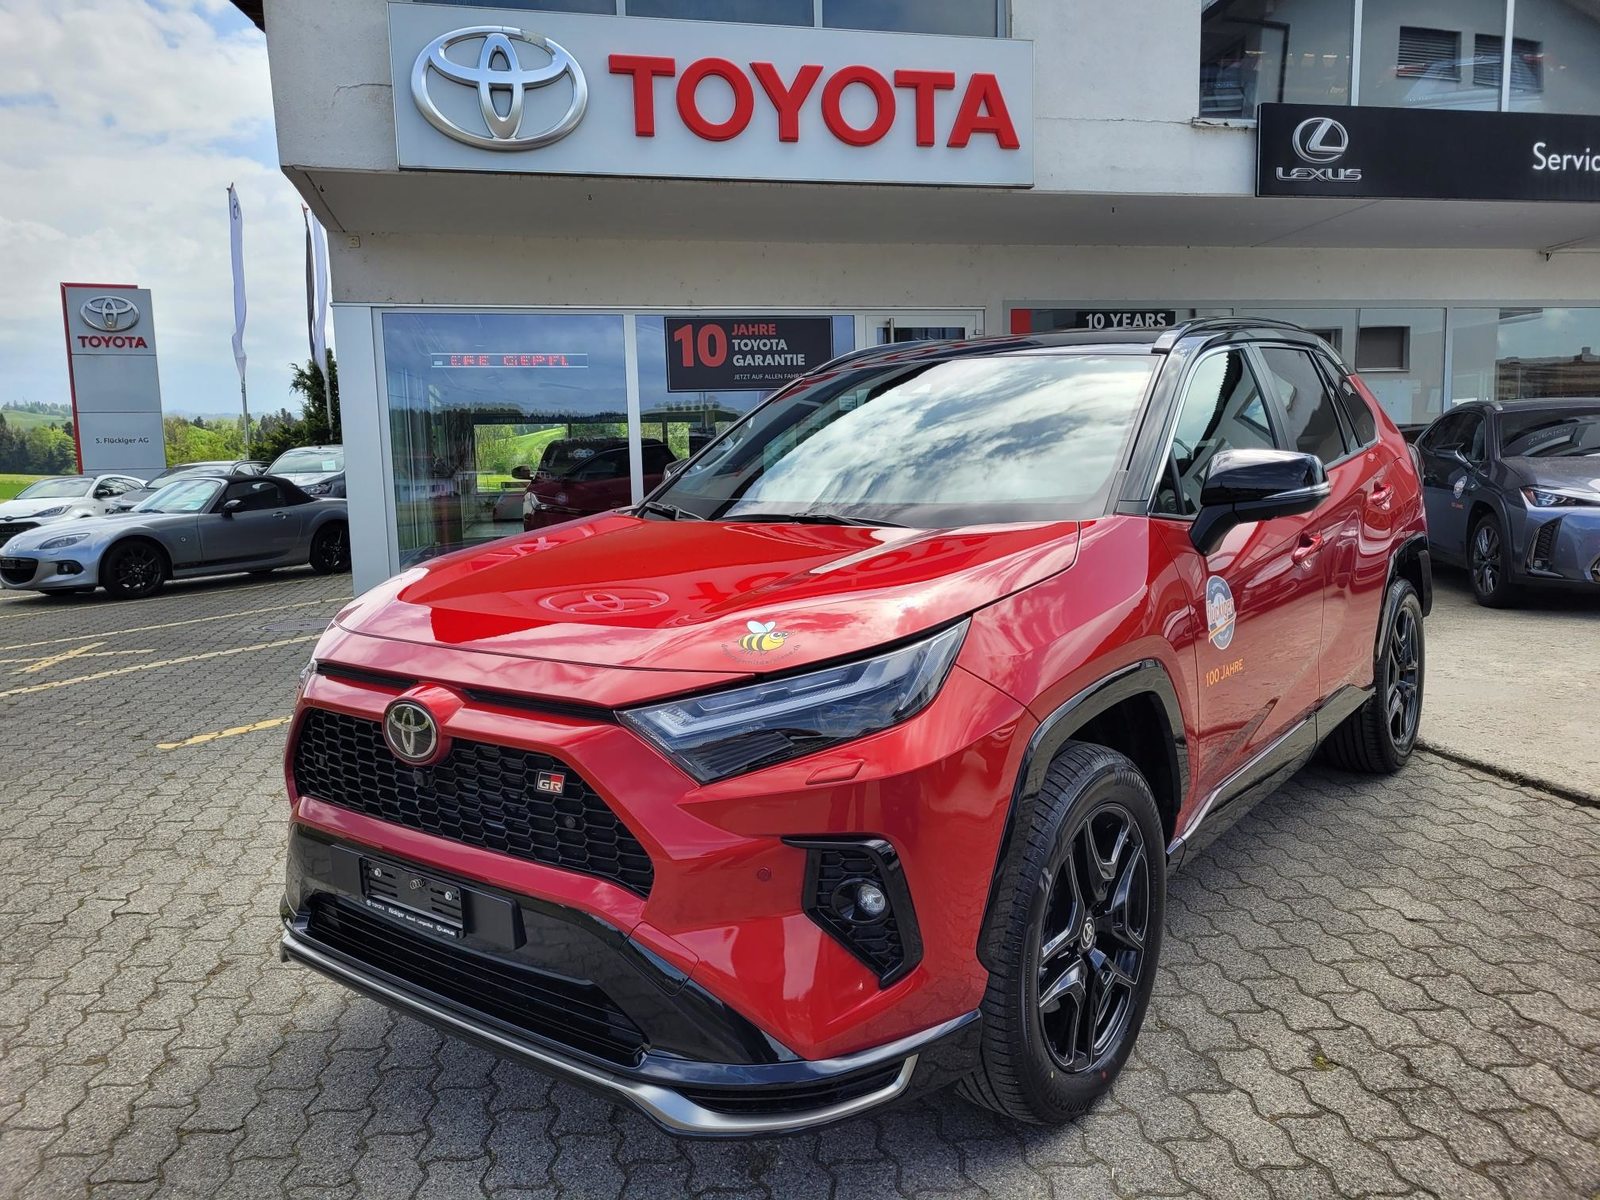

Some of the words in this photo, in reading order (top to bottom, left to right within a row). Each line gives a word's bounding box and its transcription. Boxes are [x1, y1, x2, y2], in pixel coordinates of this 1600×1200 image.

[608, 54, 1020, 149] TOYOTA
[1276, 166, 1362, 182] LEXUS
[1086, 313, 1105, 329] 10
[1110, 313, 1167, 328] YEARS
[732, 324, 776, 336] JAHRE
[77, 336, 148, 349] TOYOTA
[674, 324, 728, 368] 10
[732, 339, 788, 351] TOYOTA
[733, 354, 806, 367] GARANTIE
[104, 437, 136, 445] Flückiger
[1206, 669, 1220, 687] 100
[1220, 659, 1243, 680] JAHRE
[540, 780, 562, 791] GR
